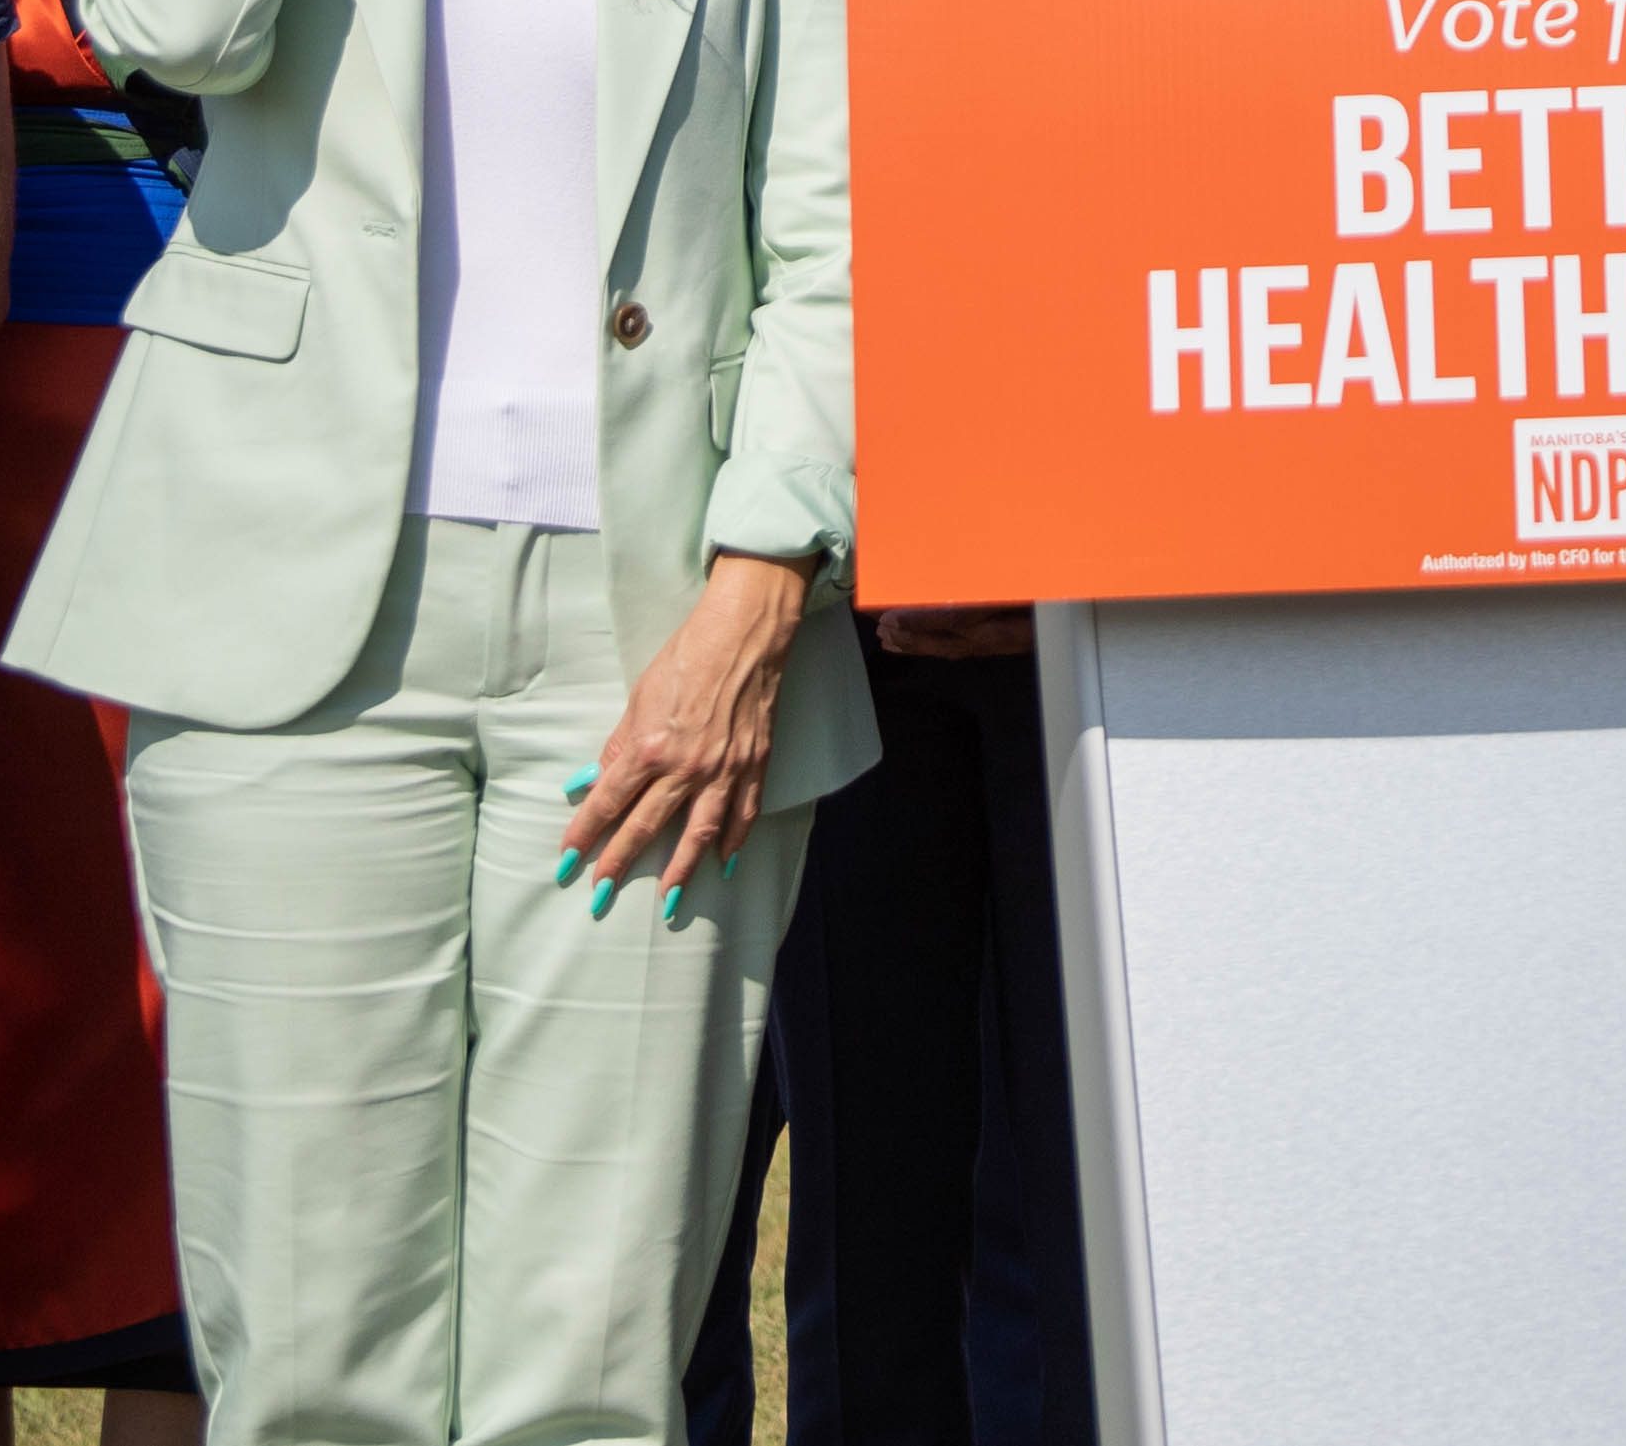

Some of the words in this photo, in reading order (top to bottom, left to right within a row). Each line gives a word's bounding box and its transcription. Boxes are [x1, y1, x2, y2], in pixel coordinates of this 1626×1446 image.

[1420, 552, 1505, 573] Authorized
[1508, 552, 1527, 571] by
[1531, 550, 1556, 568] the
[1558, 548, 1590, 567] CFO
[1592, 547, 1615, 565] for
